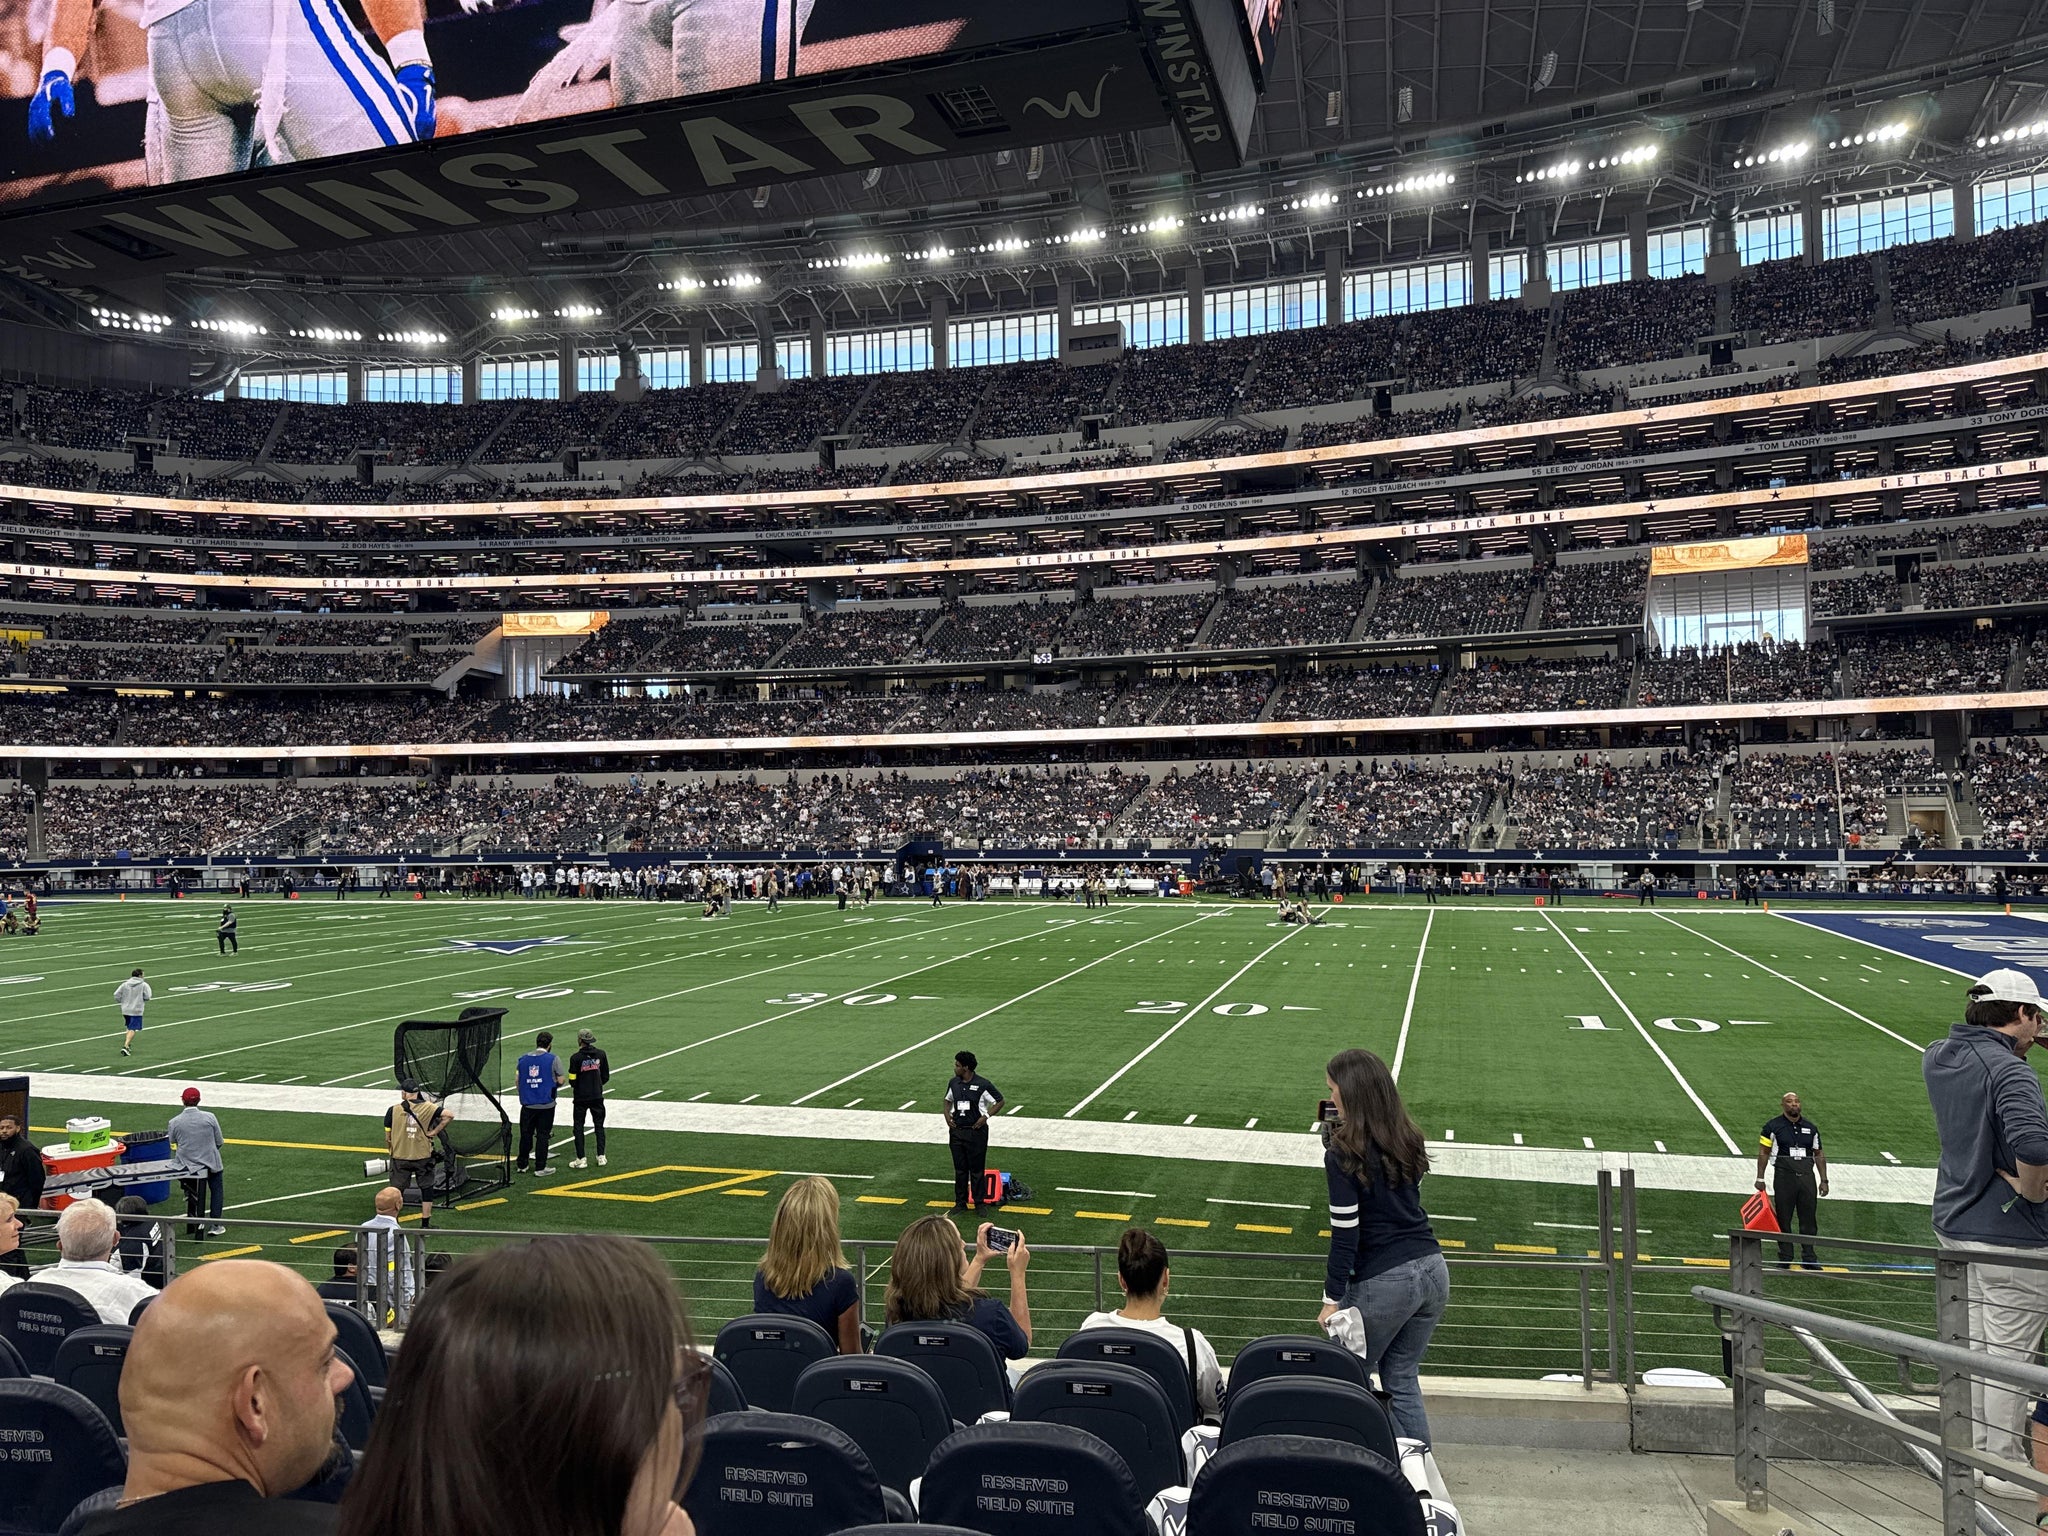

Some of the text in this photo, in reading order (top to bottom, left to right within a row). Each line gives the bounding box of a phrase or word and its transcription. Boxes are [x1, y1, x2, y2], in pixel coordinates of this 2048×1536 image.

[103, 94, 946, 257] WINSTAR
[1970, 417, 1983, 426] 33
[1988, 412, 2017, 423] TONY
[1758, 442, 1779, 450] TOM
[1782, 438, 1820, 448] LANDRY
[1562, 464, 1578, 472] ROY
[1580, 460, 1614, 471] JORDAN
[1881, 475, 1920, 488] GET
[1944, 464, 2003, 482] BACK
[1352, 486, 1377, 494] ROGER
[1379, 481, 1416, 492] STAUBACH
[1208, 500, 1238, 509] PERKINS
[920, 522, 952, 530] MEREDITH
[1402, 511, 1564, 536] GET BACK HOME
[28, 527, 61, 536] WRIGHT
[1016, 548, 1150, 566] GET BACK HOME
[16, 566, 64, 577] HOME
[710, 572, 744, 580] BACK
[760, 569, 796, 578] HOME
[416, 579, 454, 587] HOME
[451, 988, 575, 1000] 40
[764, 992, 898, 1006] 30
[1124, 1000, 1270, 1017] 20
[1563, 1015, 1722, 1033] 10
[18, 1309, 62, 1324] RESERVED
[17, 1320, 66, 1337] FIELD SUITE
[10, 1448, 53, 1462] SUITE
[724, 1466, 808, 1486] RESERVED
[981, 1474, 1069, 1494] RESERVED
[720, 1487, 814, 1508] FIELD SUITE
[1258, 1490, 1350, 1512] RESERVED
[976, 1495, 1075, 1516] FIELD SUITE
[1251, 1512, 1356, 1535] FIELD SUITE
